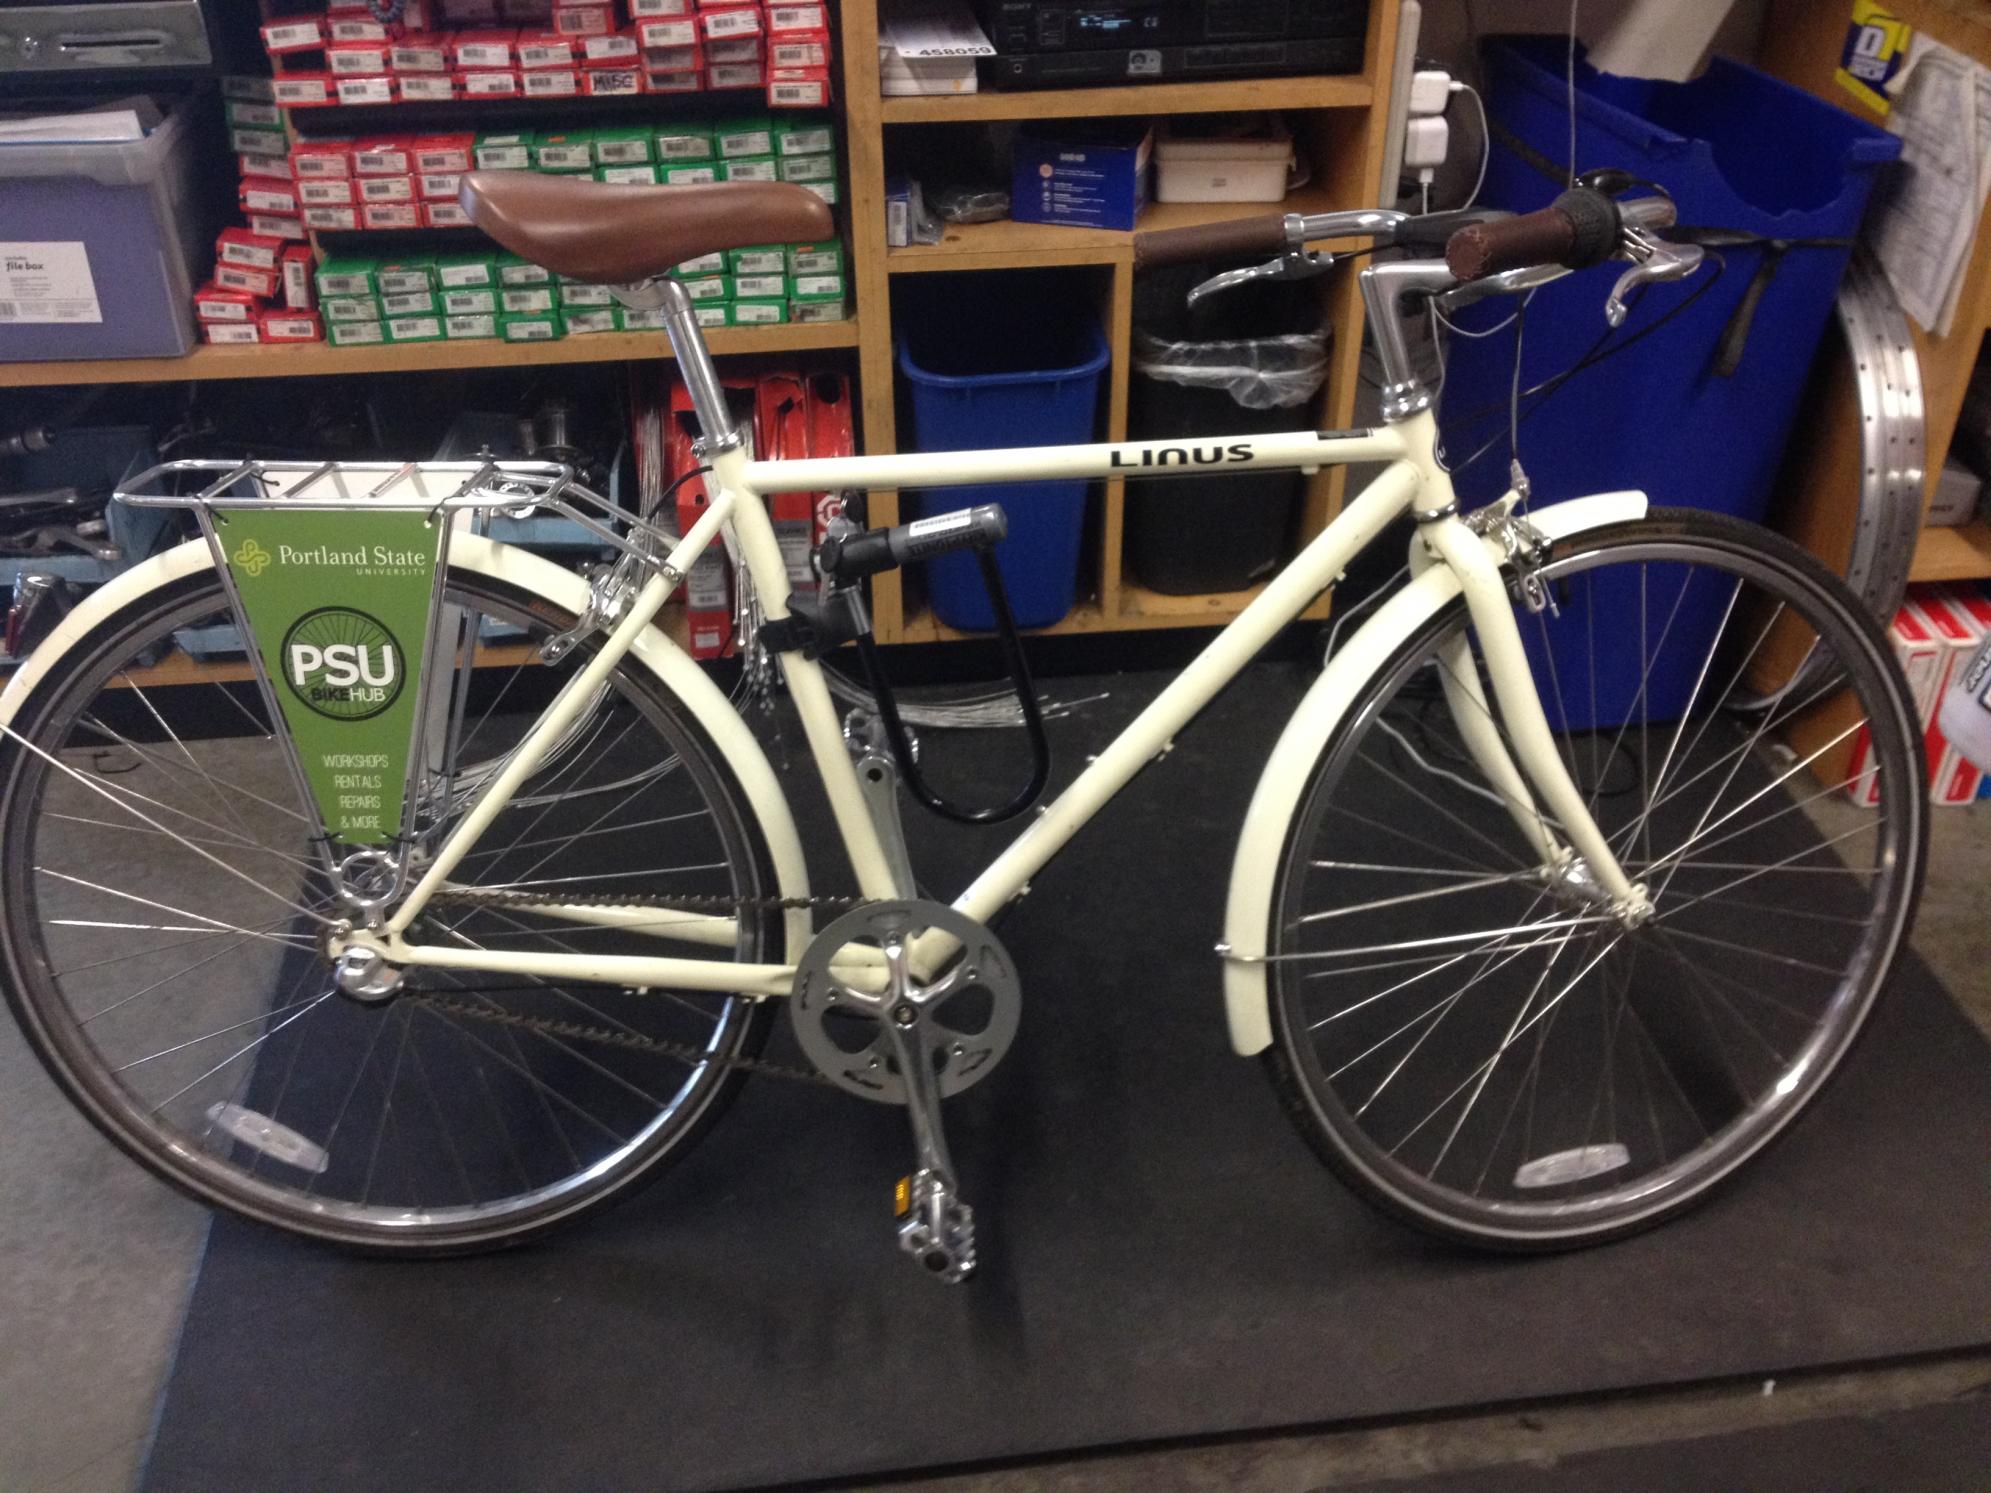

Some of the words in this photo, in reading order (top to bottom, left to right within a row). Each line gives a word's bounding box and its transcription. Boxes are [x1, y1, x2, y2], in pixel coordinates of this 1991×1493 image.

[7, 262, 23, 272] file
[25, 262, 44, 270] box
[279, 545, 368, 565] Portland
[374, 545, 426, 565] State
[356, 568, 426, 576] UNIVERSITY
[291, 644, 395, 687] PSU
[322, 754, 389, 768] WORKSHOPS
[334, 775, 382, 788] RENTALS
[339, 795, 381, 808] REPAIRS
[341, 815, 350, 829] &
[352, 815, 381, 829] MORE
